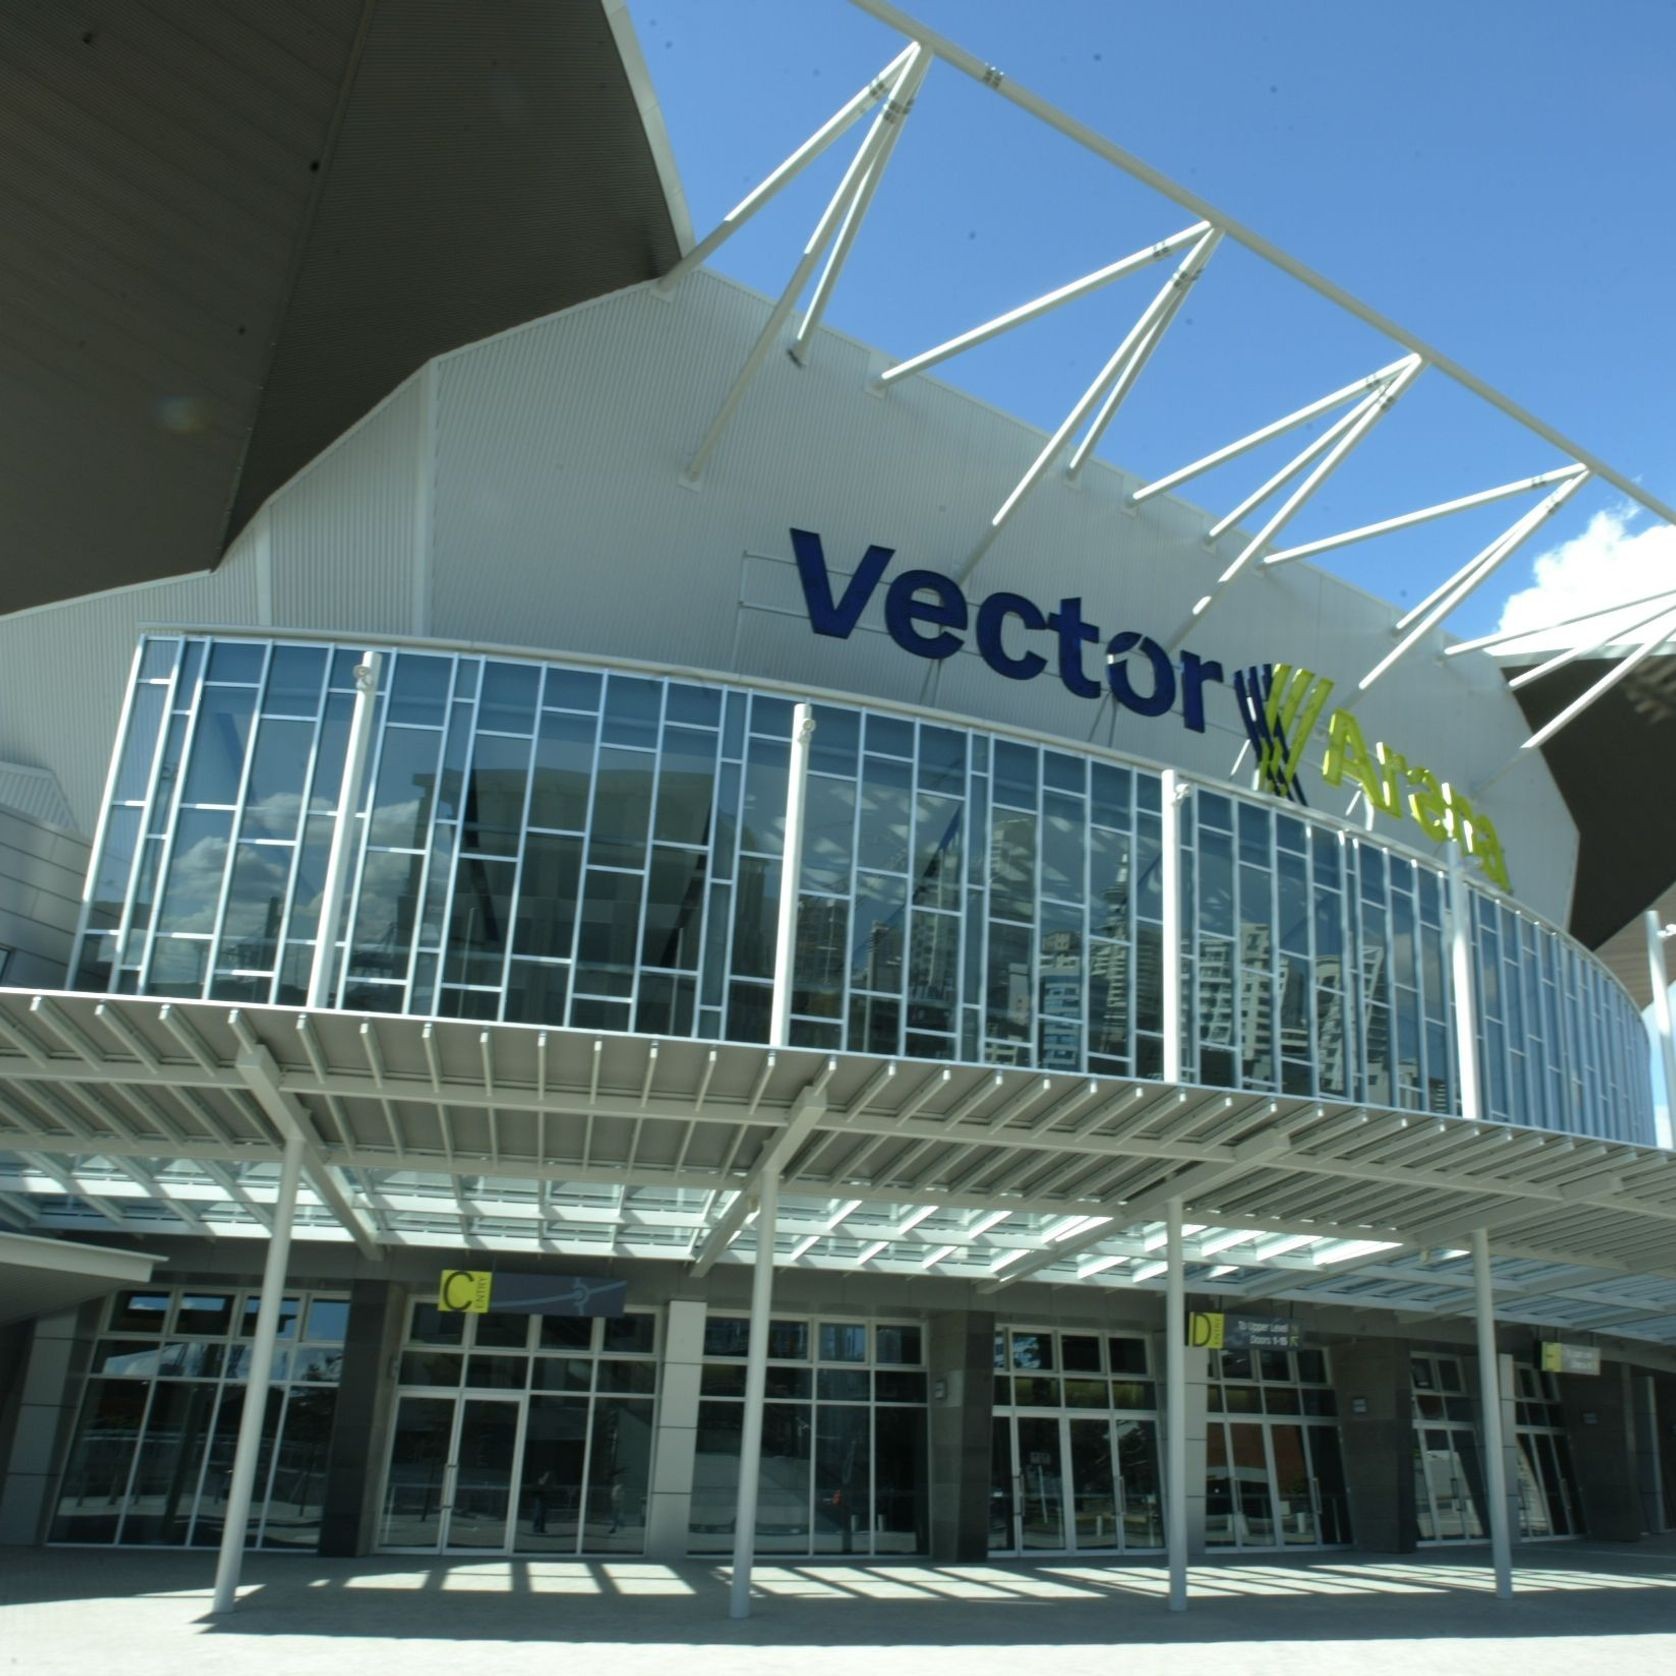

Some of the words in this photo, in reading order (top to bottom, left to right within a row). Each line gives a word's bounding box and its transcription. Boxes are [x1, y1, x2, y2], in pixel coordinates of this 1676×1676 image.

[790, 528, 1223, 733] Vector
[1322, 708, 1513, 895] Arena
[444, 1271, 474, 1310] C
[1193, 1313, 1211, 1347] D
